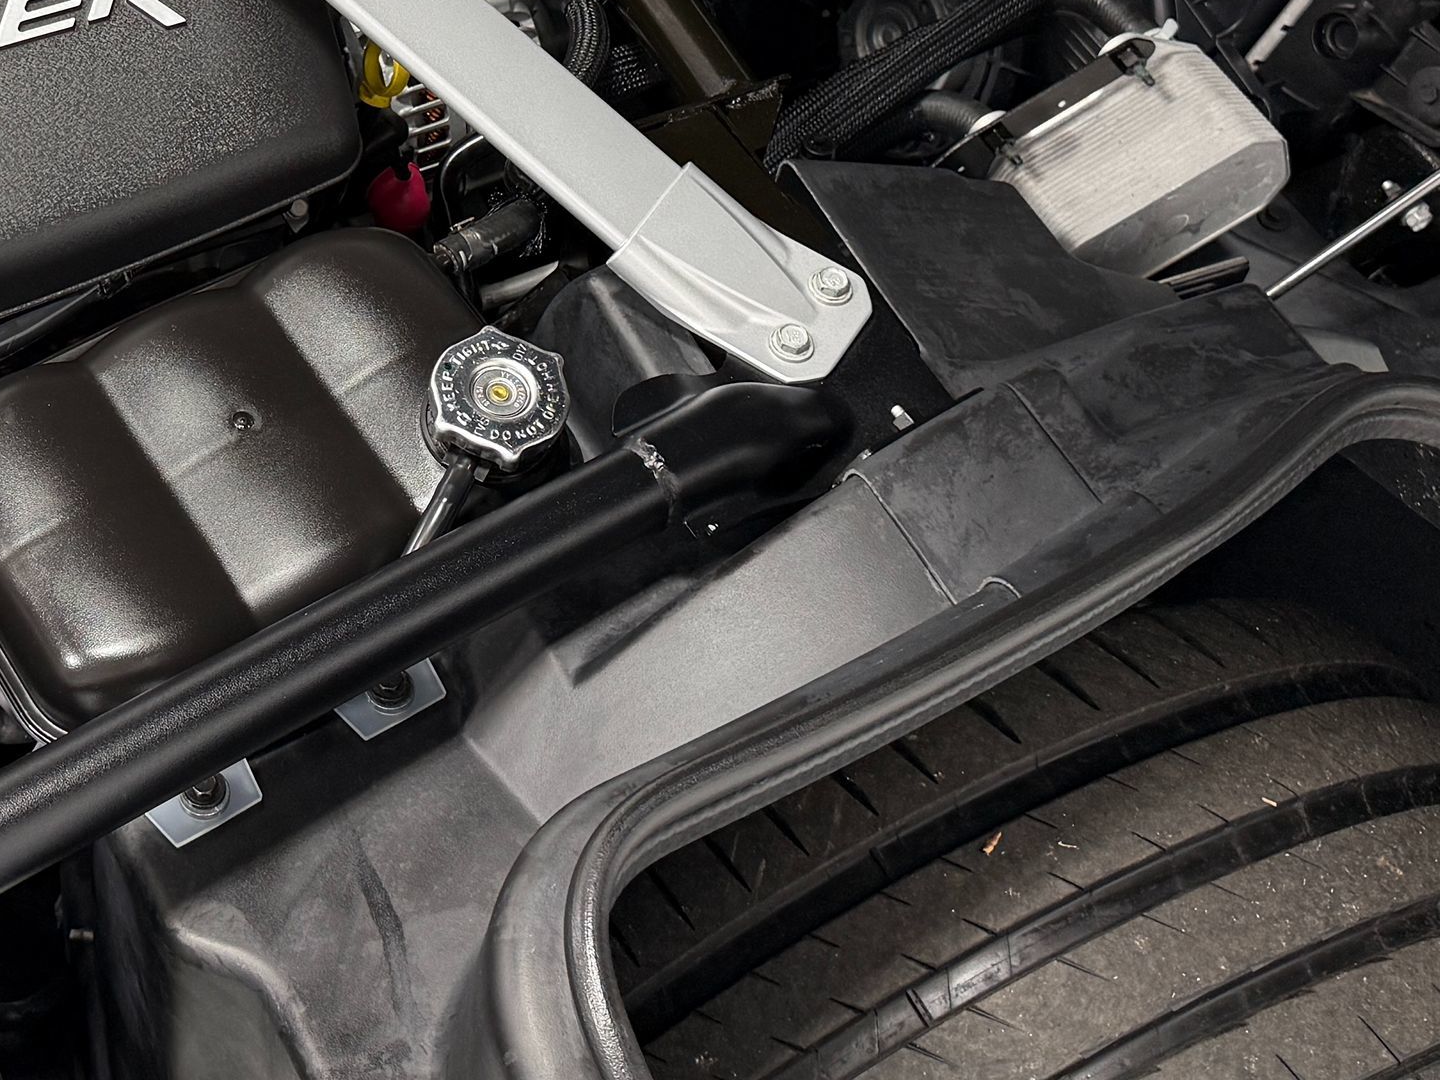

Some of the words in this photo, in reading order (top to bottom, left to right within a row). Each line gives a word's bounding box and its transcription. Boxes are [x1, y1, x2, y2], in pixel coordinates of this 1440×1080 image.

[442, 371, 456, 412] KEEP
[450, 340, 491, 366] TIGHT
[515, 419, 545, 439] NOT
